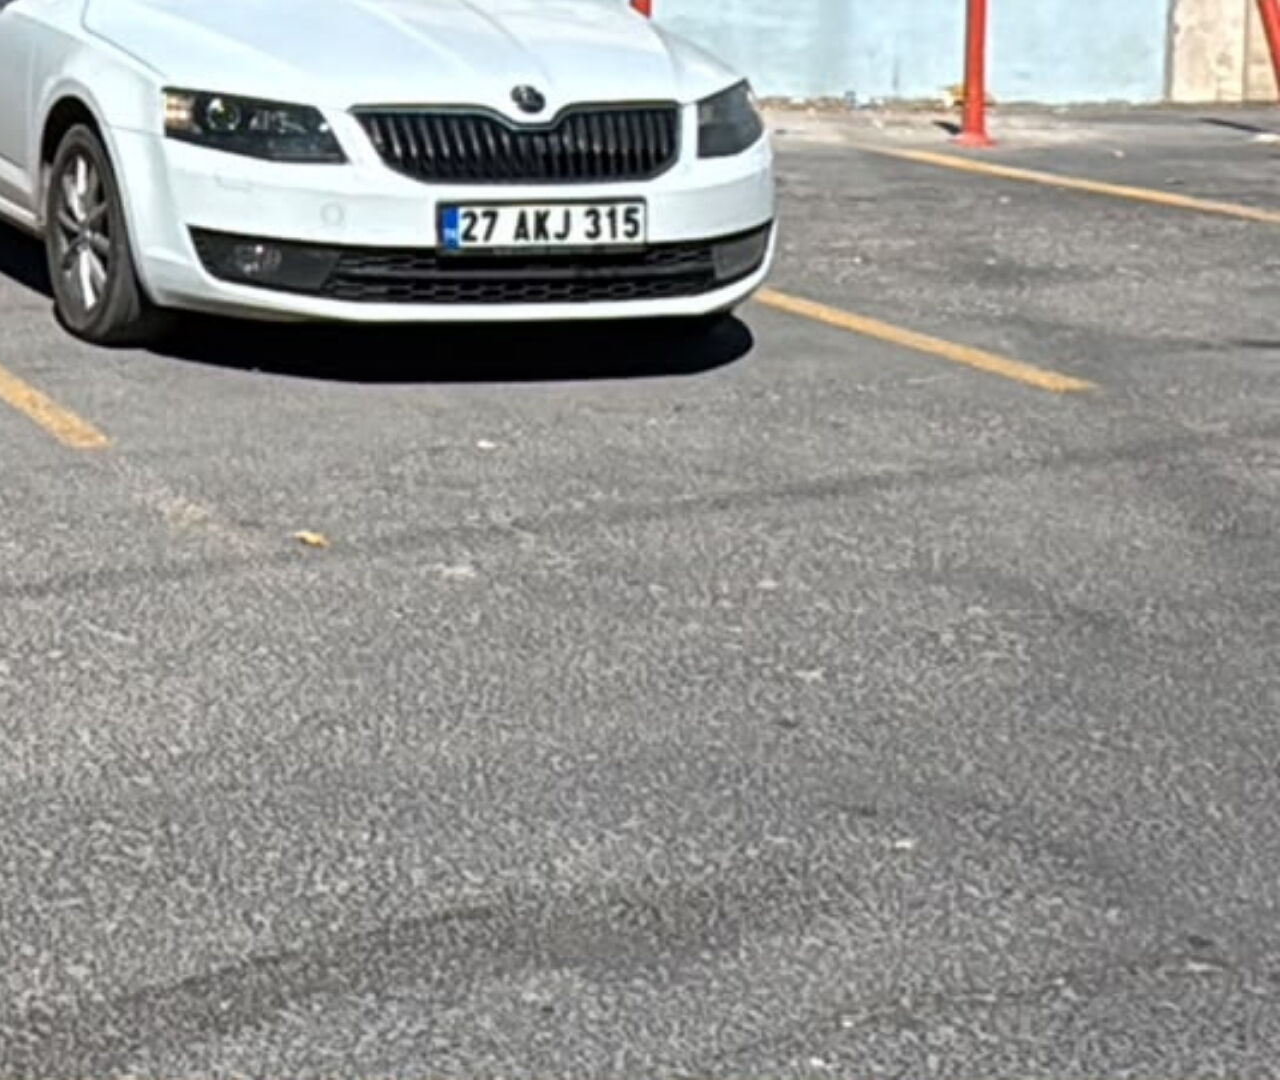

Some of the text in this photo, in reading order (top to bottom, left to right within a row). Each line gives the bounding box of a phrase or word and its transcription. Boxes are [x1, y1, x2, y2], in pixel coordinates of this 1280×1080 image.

[461, 210, 499, 242] 27
[513, 209, 572, 241] AKJ
[584, 206, 640, 239] 315
